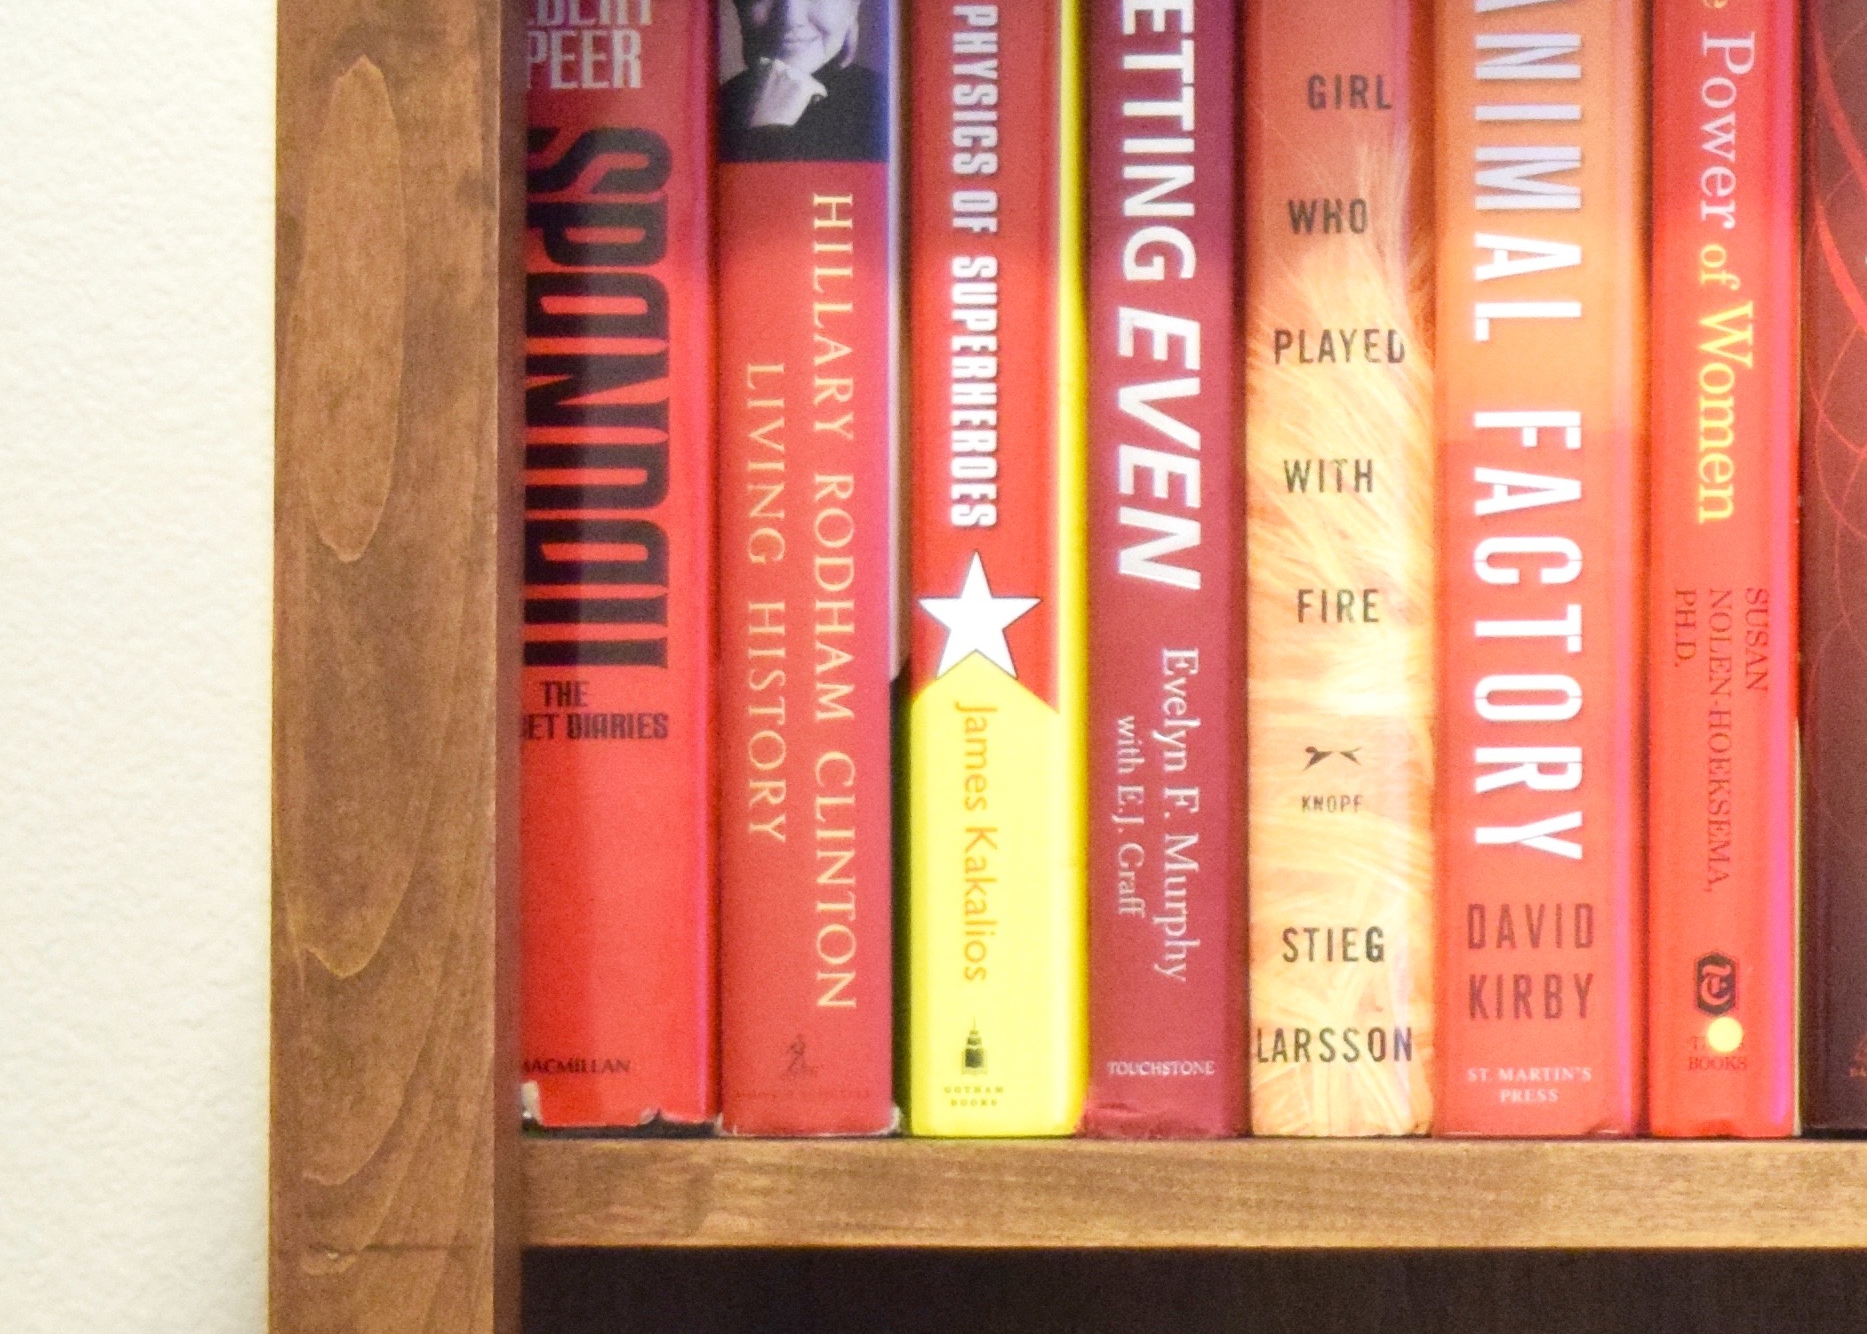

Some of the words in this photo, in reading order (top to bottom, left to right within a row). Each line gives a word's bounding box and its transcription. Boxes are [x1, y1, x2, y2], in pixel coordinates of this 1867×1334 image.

[952, 5, 998, 177] PHYSICS
[1307, 75, 1393, 110] GIRL
[1701, 31, 1756, 229] Power
[952, 192, 998, 233] OF
[1287, 199, 1369, 235] WHO
[1700, 245, 1739, 289] of
[811, 193, 855, 440] HILLARY
[1274, 328, 1407, 365] PLAYED
[951, 255, 998, 528] SUPERHEROES
[1698, 301, 1756, 524] Women
[746, 364, 786, 563] LIVING
[1117, 307, 1201, 590] EVEN
[1283, 458, 1374, 494] WITH
[812, 474, 855, 721] RODHAM
[1296, 588, 1381, 623] FIRE
[1474, 410, 1583, 860] FACTORY
[1674, 589, 1698, 668] PH.D.
[1746, 587, 1769, 693] SUSAN
[539, 679, 589, 708] THE
[1160, 648, 1200, 772] Evelyn
[567, 713, 669, 739] DIARIES
[746, 602, 788, 845] HISTORY
[1116, 715, 1145, 774] with
[954, 701, 999, 812] James
[1116, 785, 1144, 833] E.J.
[1163, 787, 1198, 818] F.
[1301, 794, 1364, 813] KNOPF
[814, 752, 857, 1009] CLINTON
[964, 825, 999, 982] Kakalios
[1116, 844, 1145, 918] Graff
[1154, 831, 1201, 981] Murphy
[1467, 902, 1594, 949] DAVID
[1281, 926, 1387, 964] STIEG
[1468, 973, 1594, 1021] KIRBY
[1256, 1026, 1414, 1063] LARSSON
[1107, 1061, 1216, 1077] TOUCHSTONE
[1466, 1067, 1494, 1083] ST.
[1499, 1066, 1593, 1083] MARTIN'S
[950, 1099, 998, 1107] BOOKS
[1499, 1087, 1559, 1104] PRESS
